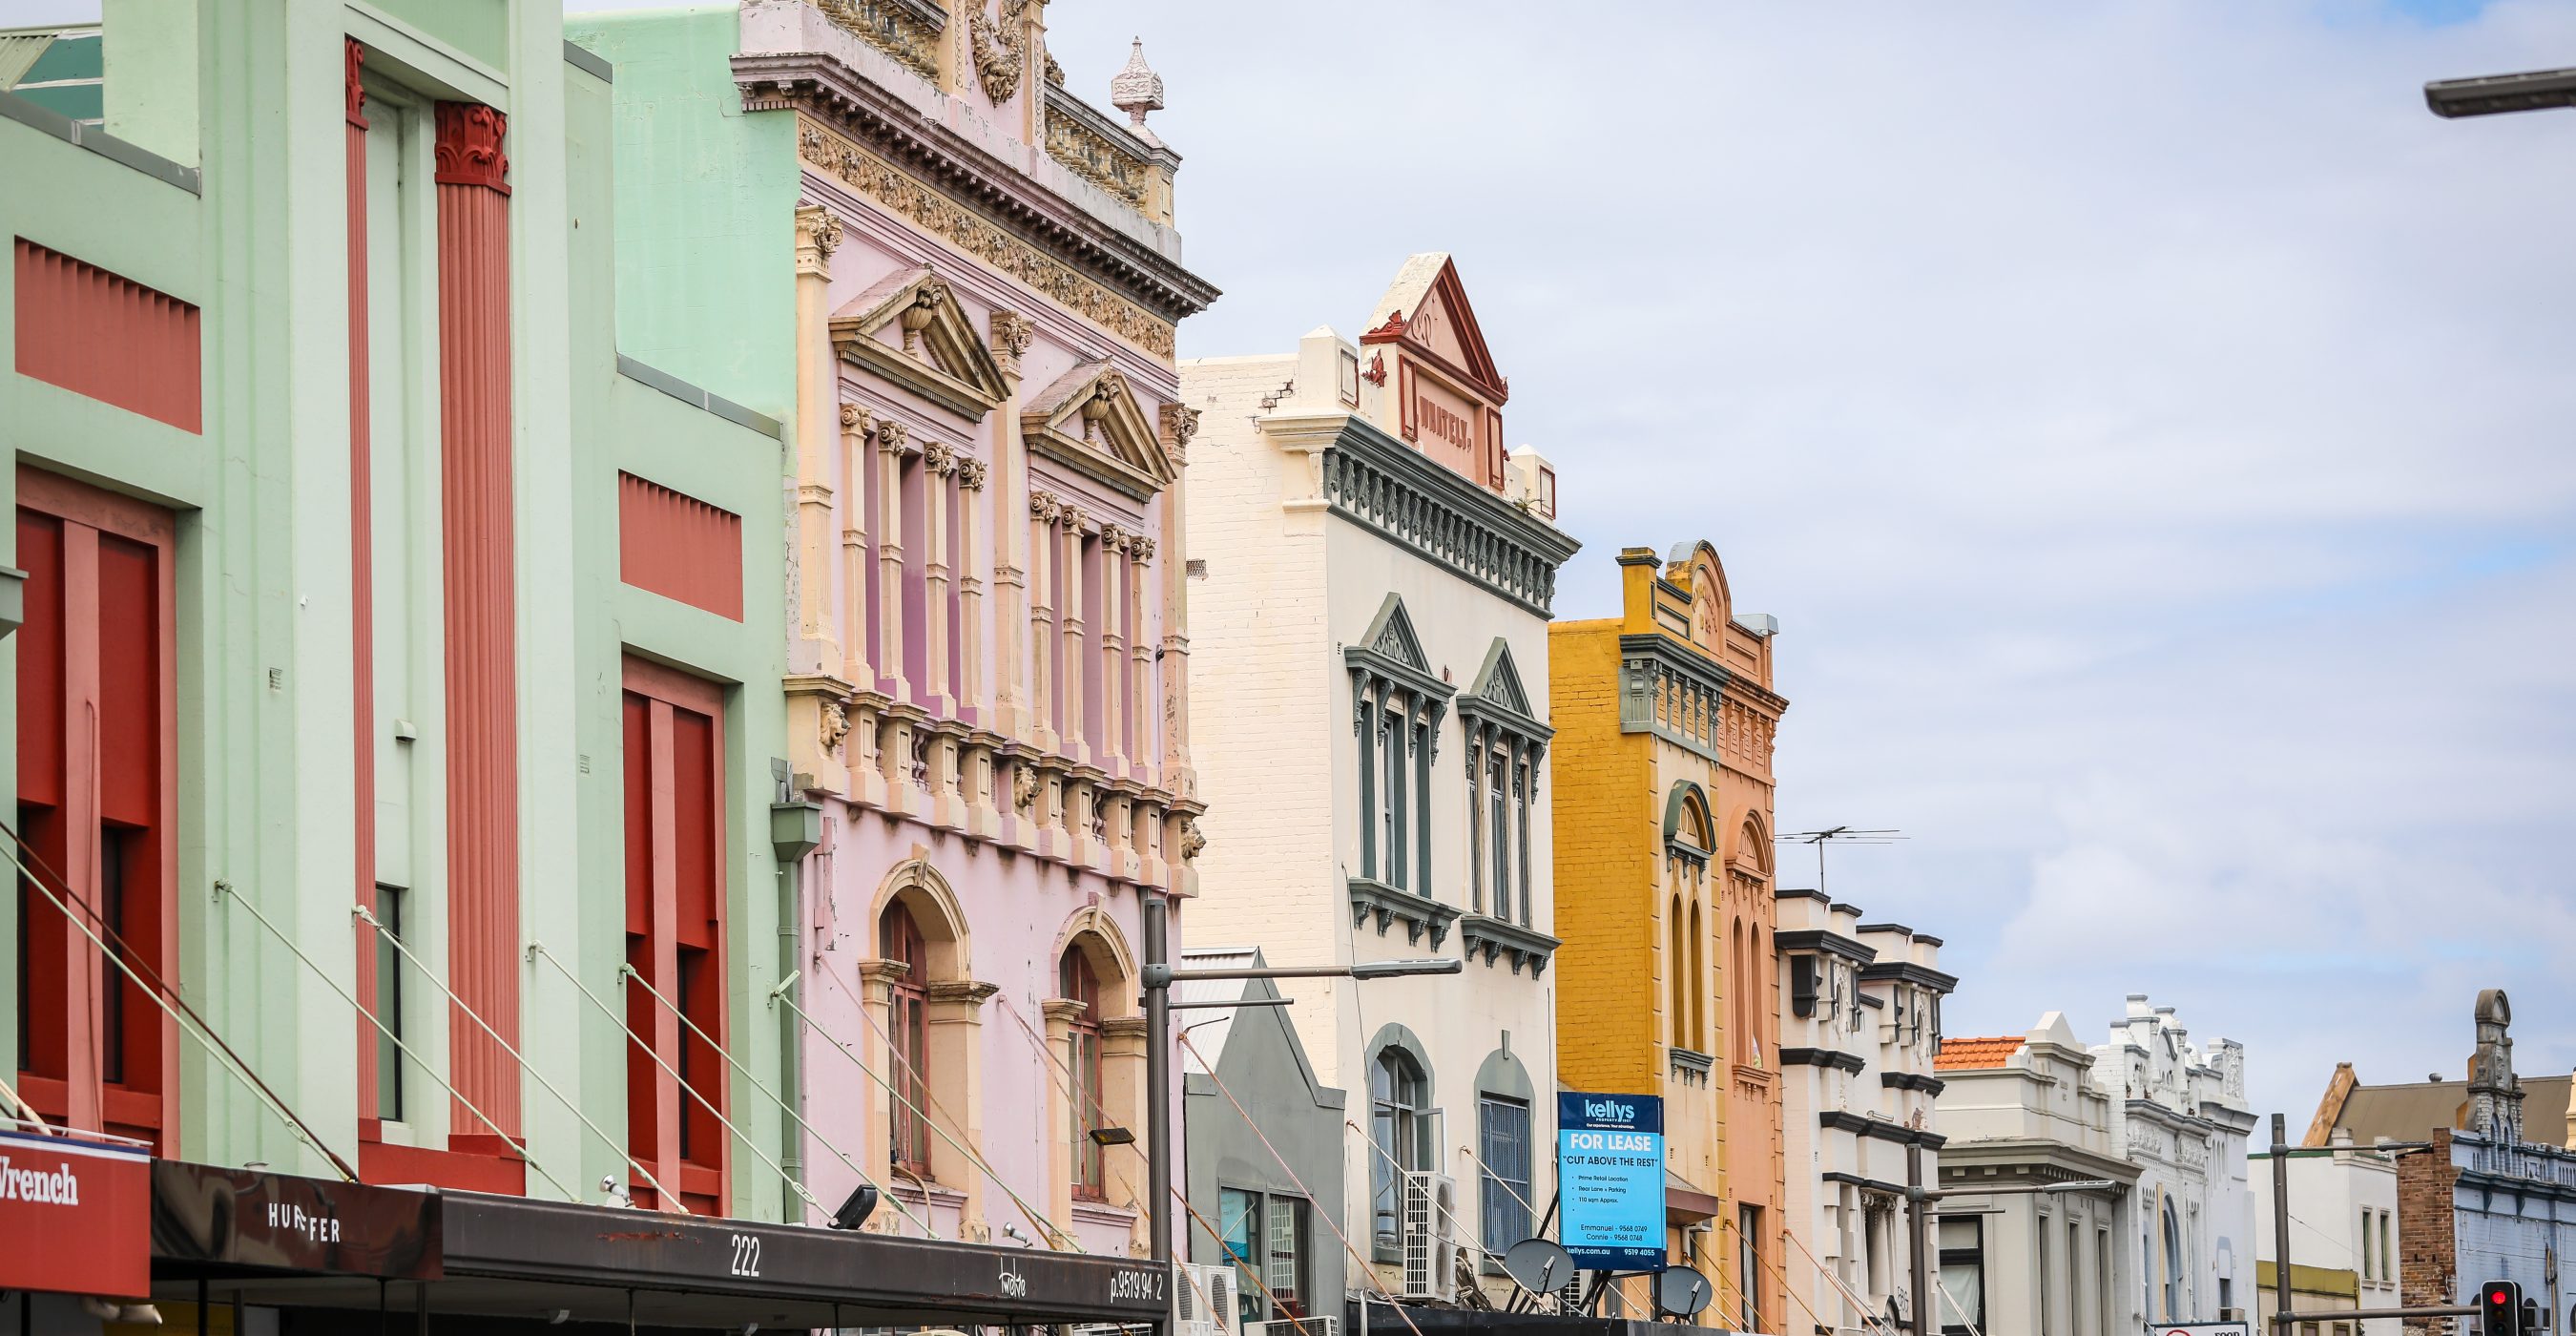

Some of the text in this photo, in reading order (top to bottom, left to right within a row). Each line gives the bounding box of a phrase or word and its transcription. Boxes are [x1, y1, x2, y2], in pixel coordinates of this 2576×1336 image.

[1585, 1099, 1634, 1122] kellys
[1570, 1133, 1652, 1152] FOR LEASE
[1587, 1156, 1617, 1165] ABOVE
[1619, 1157, 1634, 1166] THE
[731, 1234, 760, 1278] 222
[1567, 1247, 1610, 1256] kellys.com.au
[1111, 1270, 1163, 1304] p.9519 942
